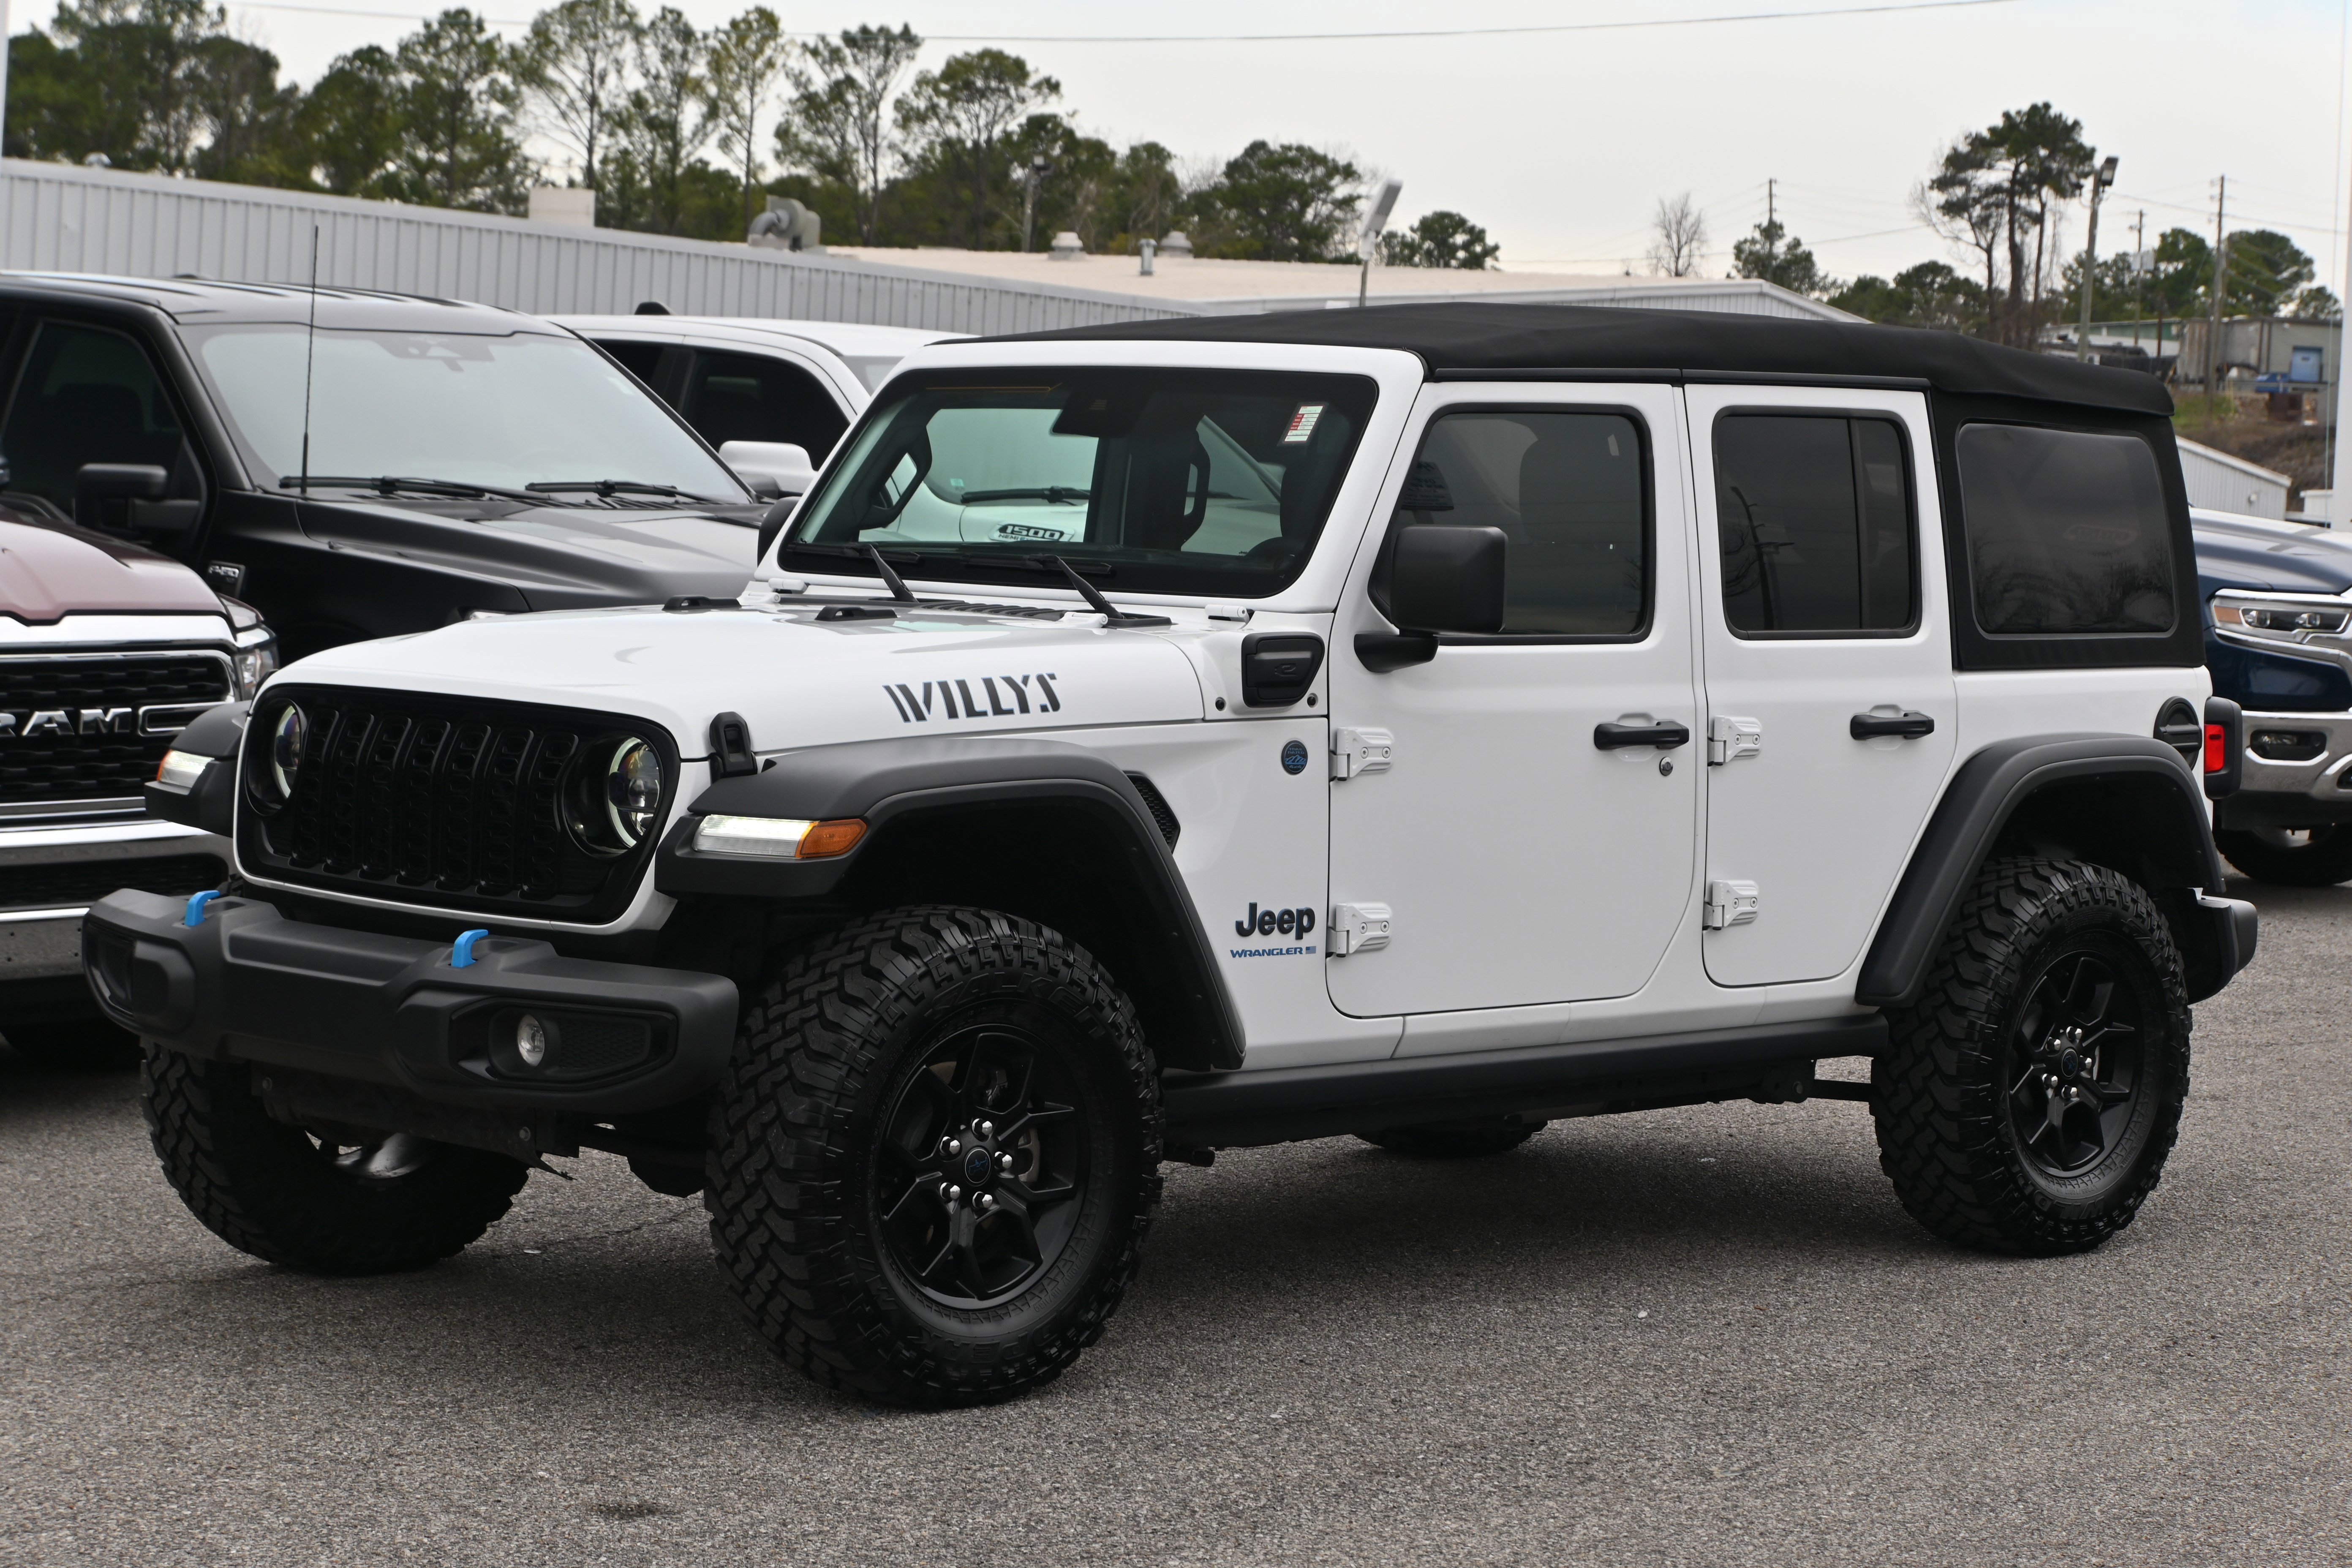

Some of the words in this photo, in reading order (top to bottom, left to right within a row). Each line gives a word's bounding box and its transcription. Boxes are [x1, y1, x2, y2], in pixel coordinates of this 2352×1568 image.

[1006, 525, 1061, 540] 1500
[882, 672, 1061, 723] WILLYS
[1235, 902, 1315, 940] Jeep
[1230, 946, 1303, 958] WRANGLER
[923, 972, 1108, 1039] FALKEN
[906, 1230, 1122, 1363] WILDPEAK
